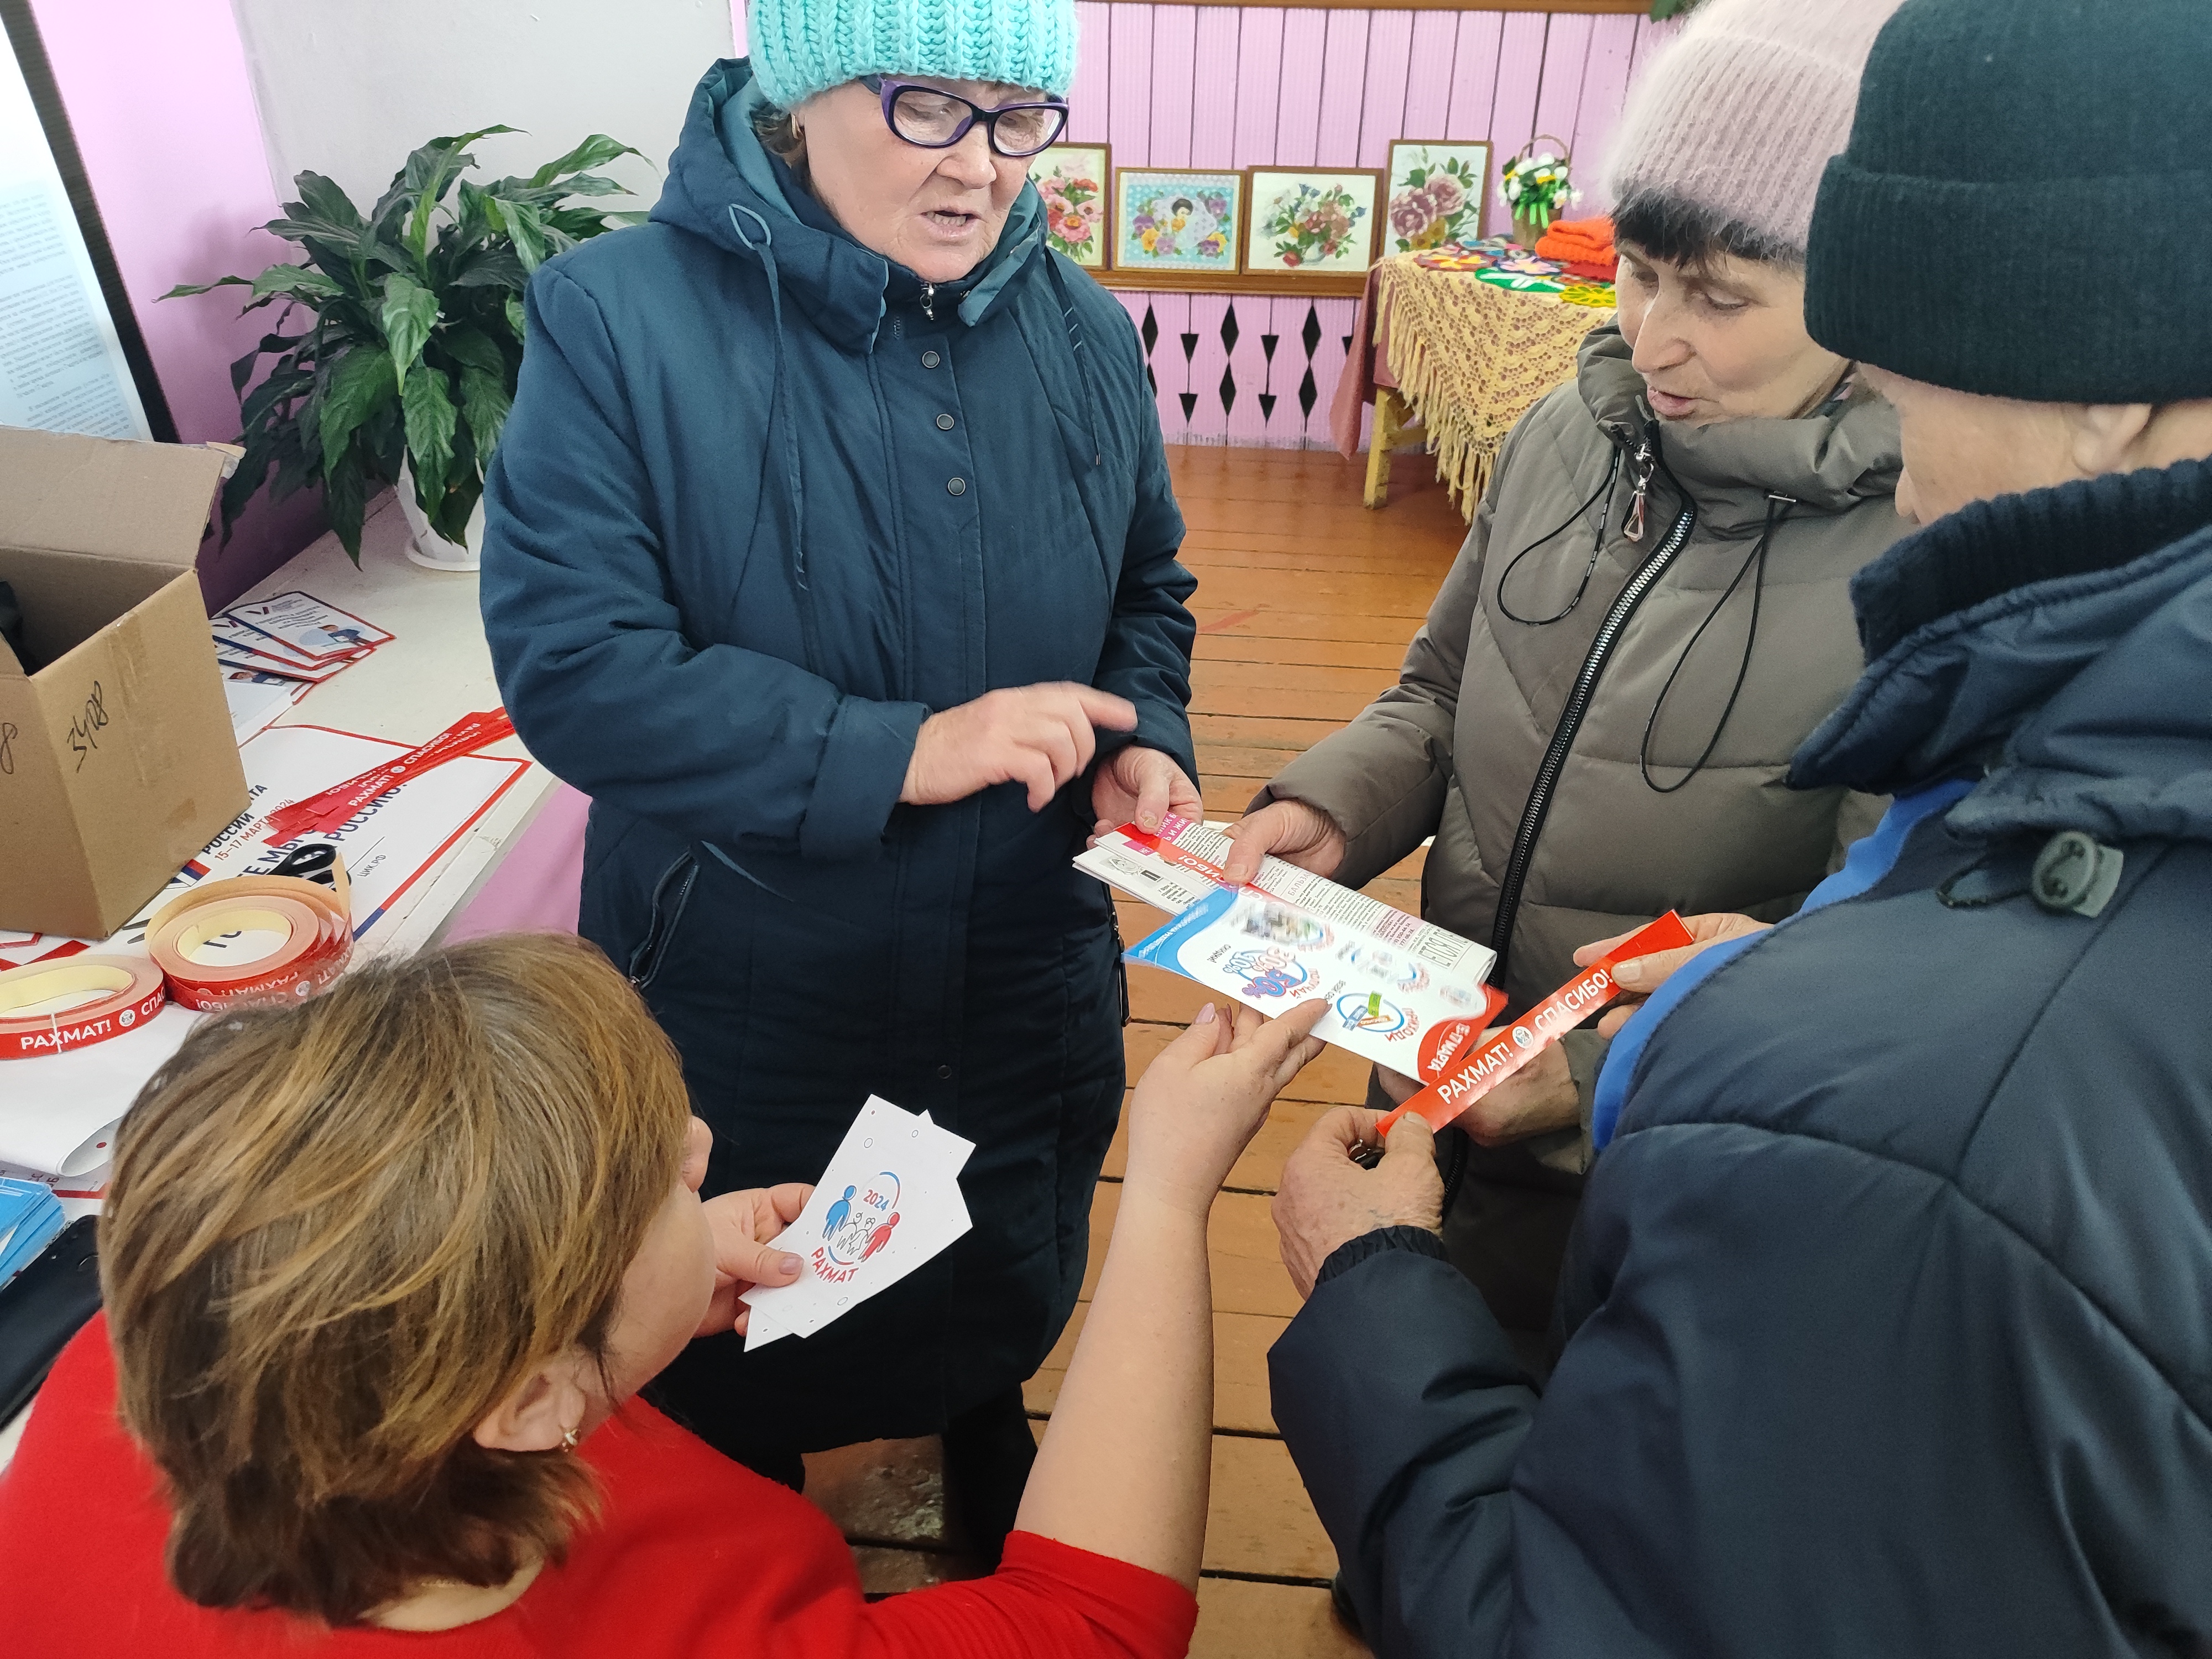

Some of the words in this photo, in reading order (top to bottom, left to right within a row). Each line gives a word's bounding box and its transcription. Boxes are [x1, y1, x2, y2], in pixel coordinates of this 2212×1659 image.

[403, 732, 453, 764] СПАСИБО!
[348, 775, 394, 806] РАХМАТ!
[323, 784, 408, 842] РОССИЮ
[202, 813, 255, 854] РОССИИ
[1242, 969, 1302, 998] 50%
[1535, 968, 1614, 1033] СПАСИБО!
[20, 1020, 112, 1050] РАХМАТ!
[1437, 1041, 1513, 1104] РАХМАТ!
[863, 1189, 890, 1211] 2024
[811, 1246, 859, 1284] РАХМАТ
